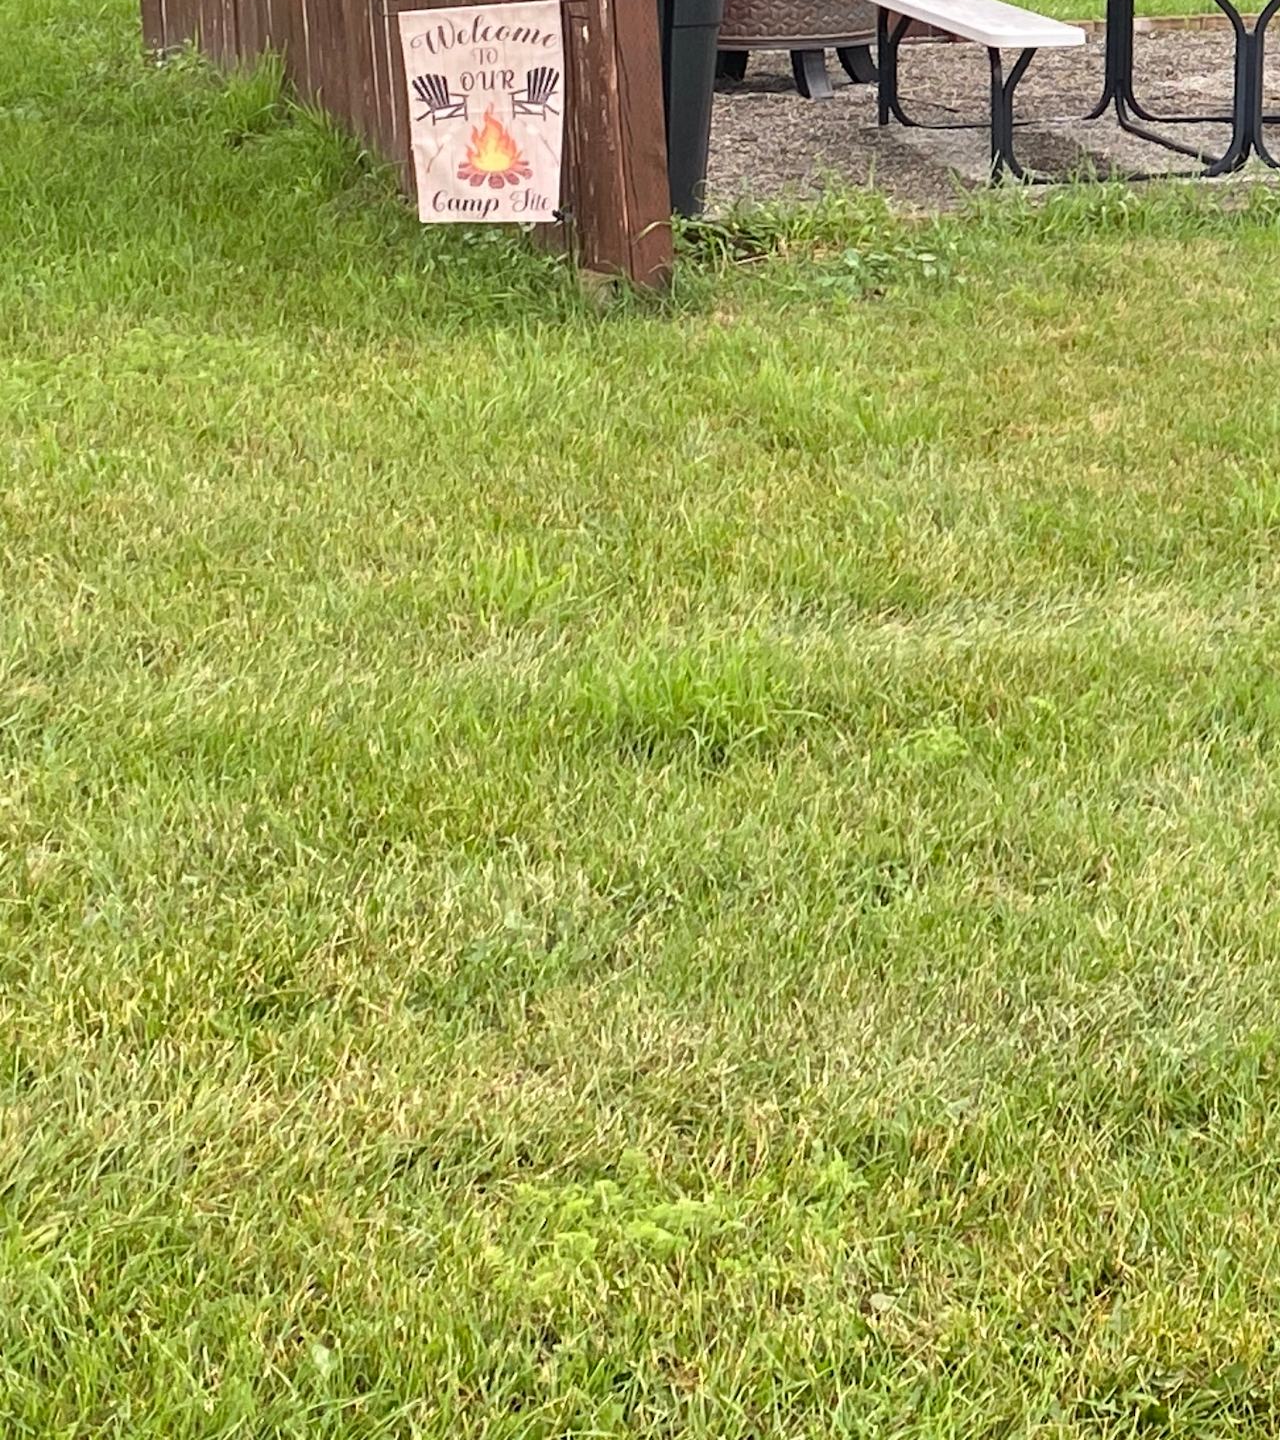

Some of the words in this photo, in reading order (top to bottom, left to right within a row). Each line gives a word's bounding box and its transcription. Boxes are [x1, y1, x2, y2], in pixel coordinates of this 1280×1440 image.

[410, 14, 560, 54] Welcome
[460, 69, 515, 91] OUR
[432, 190, 499, 218] Camp
[510, 187, 550, 213] Site
